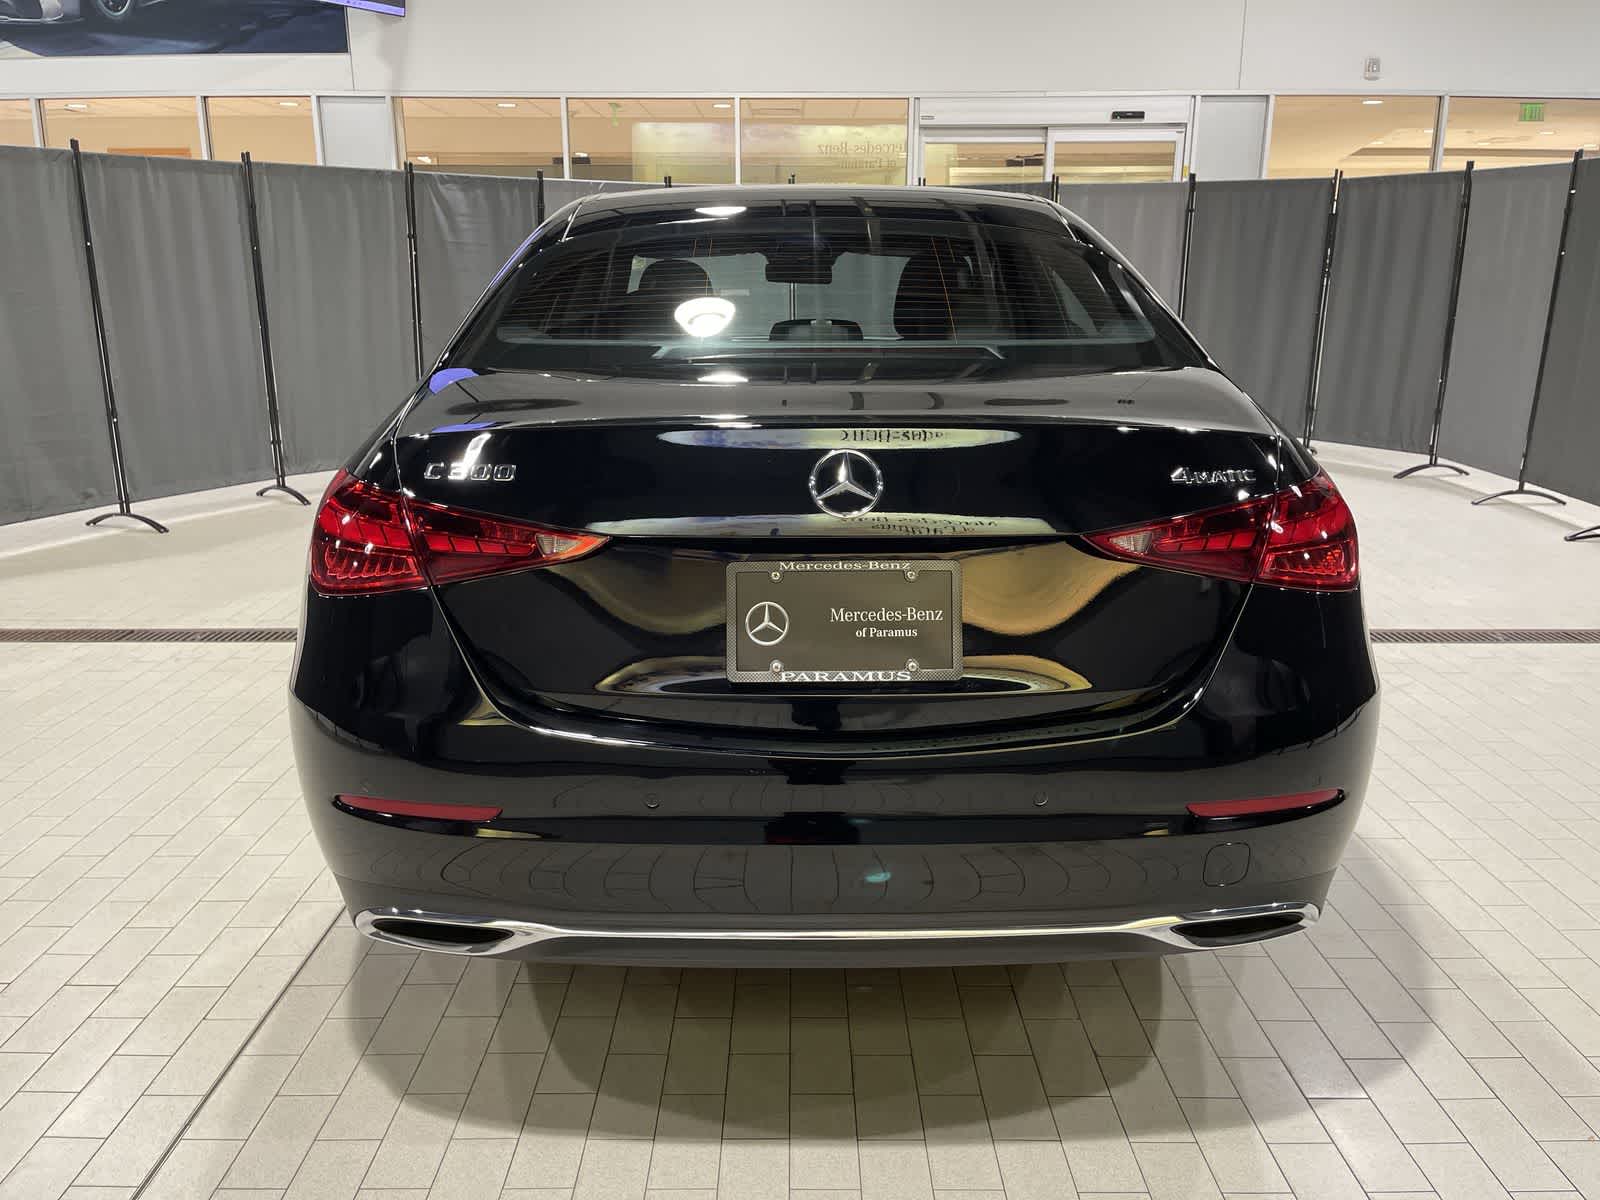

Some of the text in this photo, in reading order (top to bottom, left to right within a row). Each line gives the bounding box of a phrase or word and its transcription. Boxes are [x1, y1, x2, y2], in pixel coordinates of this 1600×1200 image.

[779, 561, 911, 571] Mercedes-Benz
[830, 607, 943, 622] Mercedes-Benz
[855, 627, 918, 638] of Paramus
[779, 671, 912, 682] PARAMUS
